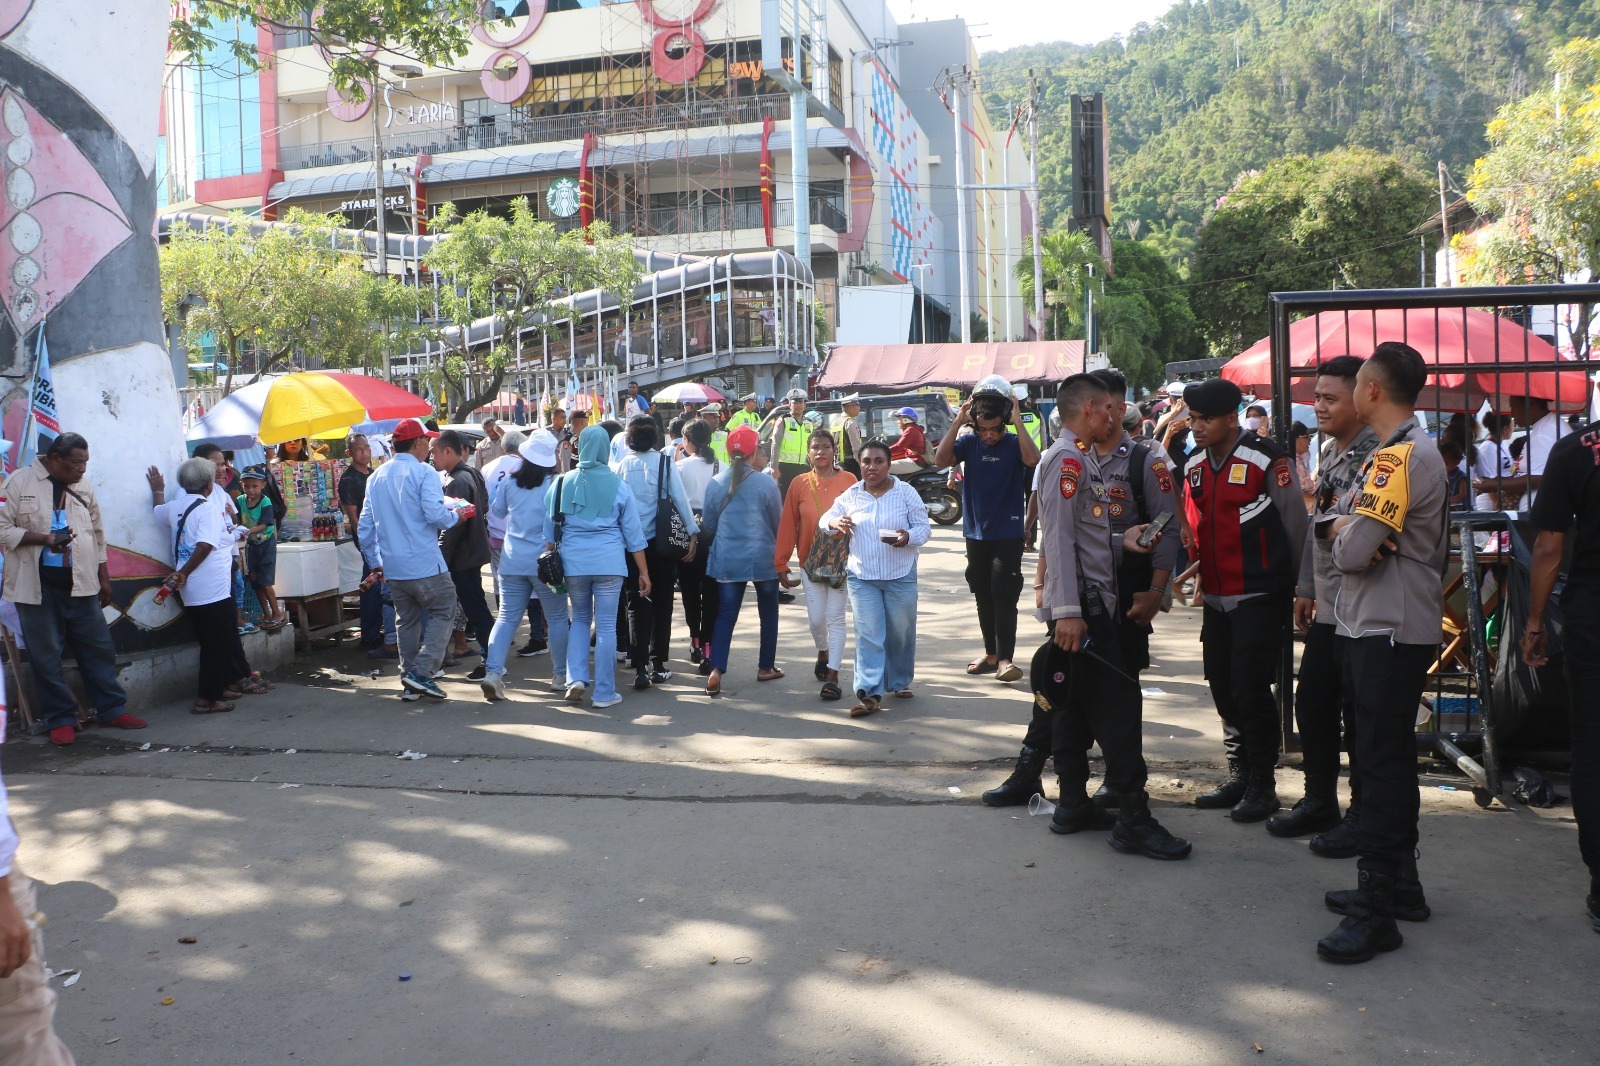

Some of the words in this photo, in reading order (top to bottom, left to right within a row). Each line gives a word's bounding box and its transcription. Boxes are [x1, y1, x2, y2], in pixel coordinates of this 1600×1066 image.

[383, 83, 455, 128] SOLARIA
[340, 195, 405, 211] STARBCKS
[962, 352, 1077, 371] POL
[1380, 499, 1400, 520] OPS
